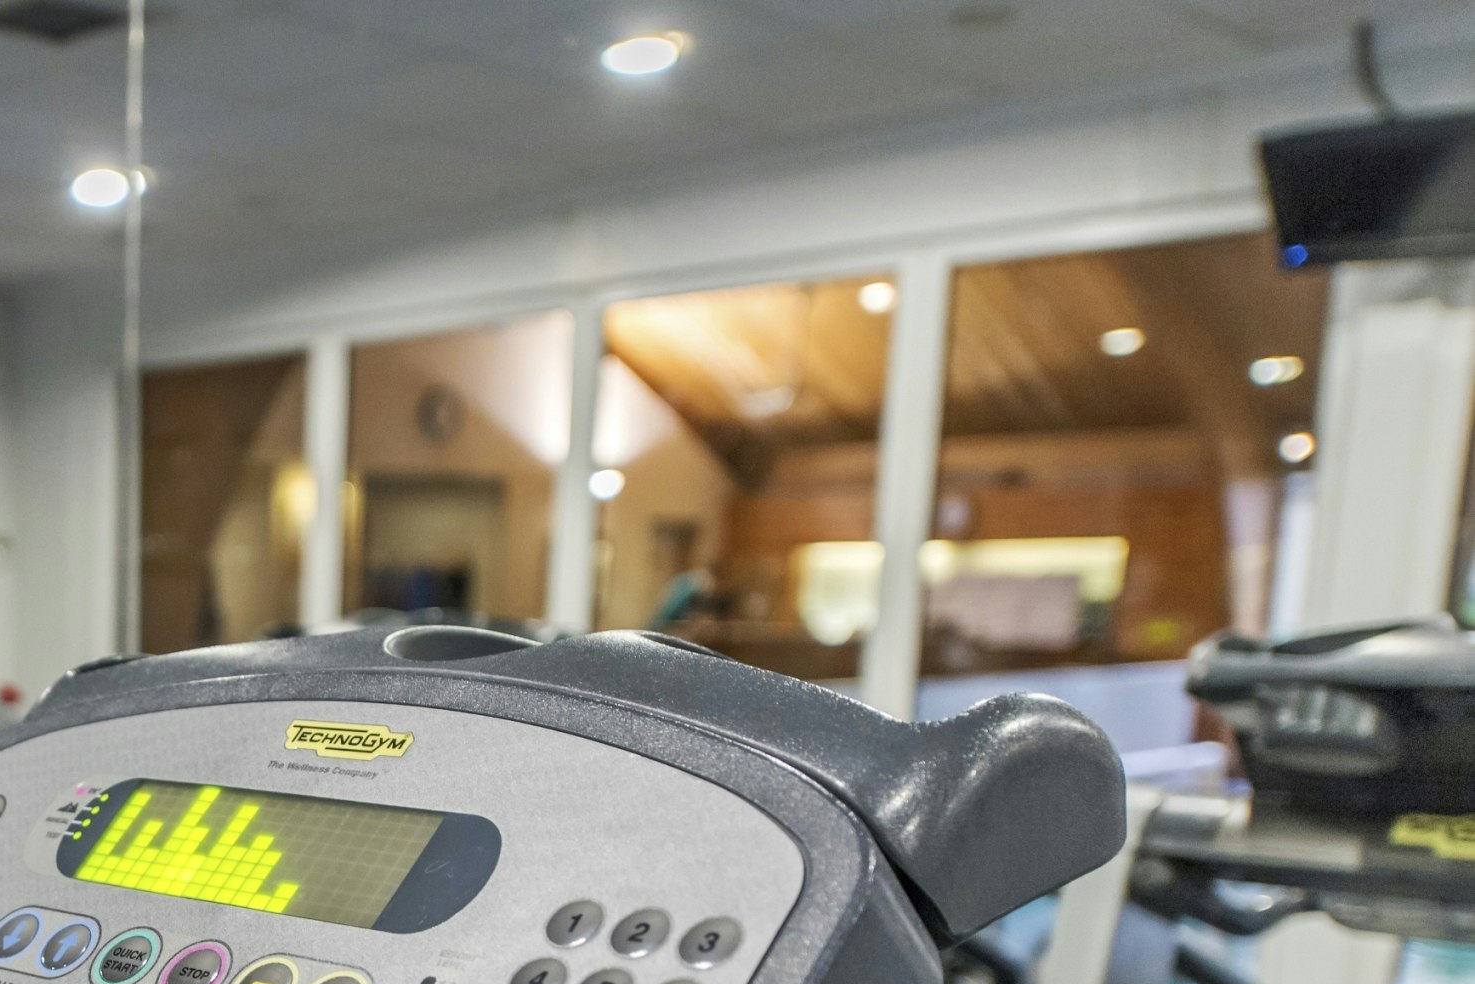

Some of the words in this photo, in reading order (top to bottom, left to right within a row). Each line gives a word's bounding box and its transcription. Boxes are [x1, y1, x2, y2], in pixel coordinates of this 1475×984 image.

[292, 725, 407, 754] TECHNOGYM
[287, 762, 330, 774] Wellness
[332, 766, 379, 779] Company
[567, 913, 584, 934] 1
[628, 922, 651, 943] 2
[697, 932, 720, 954] 3
[112, 946, 148, 963] QUICK
[103, 959, 139, 974] START
[179, 966, 211, 981] STOP
